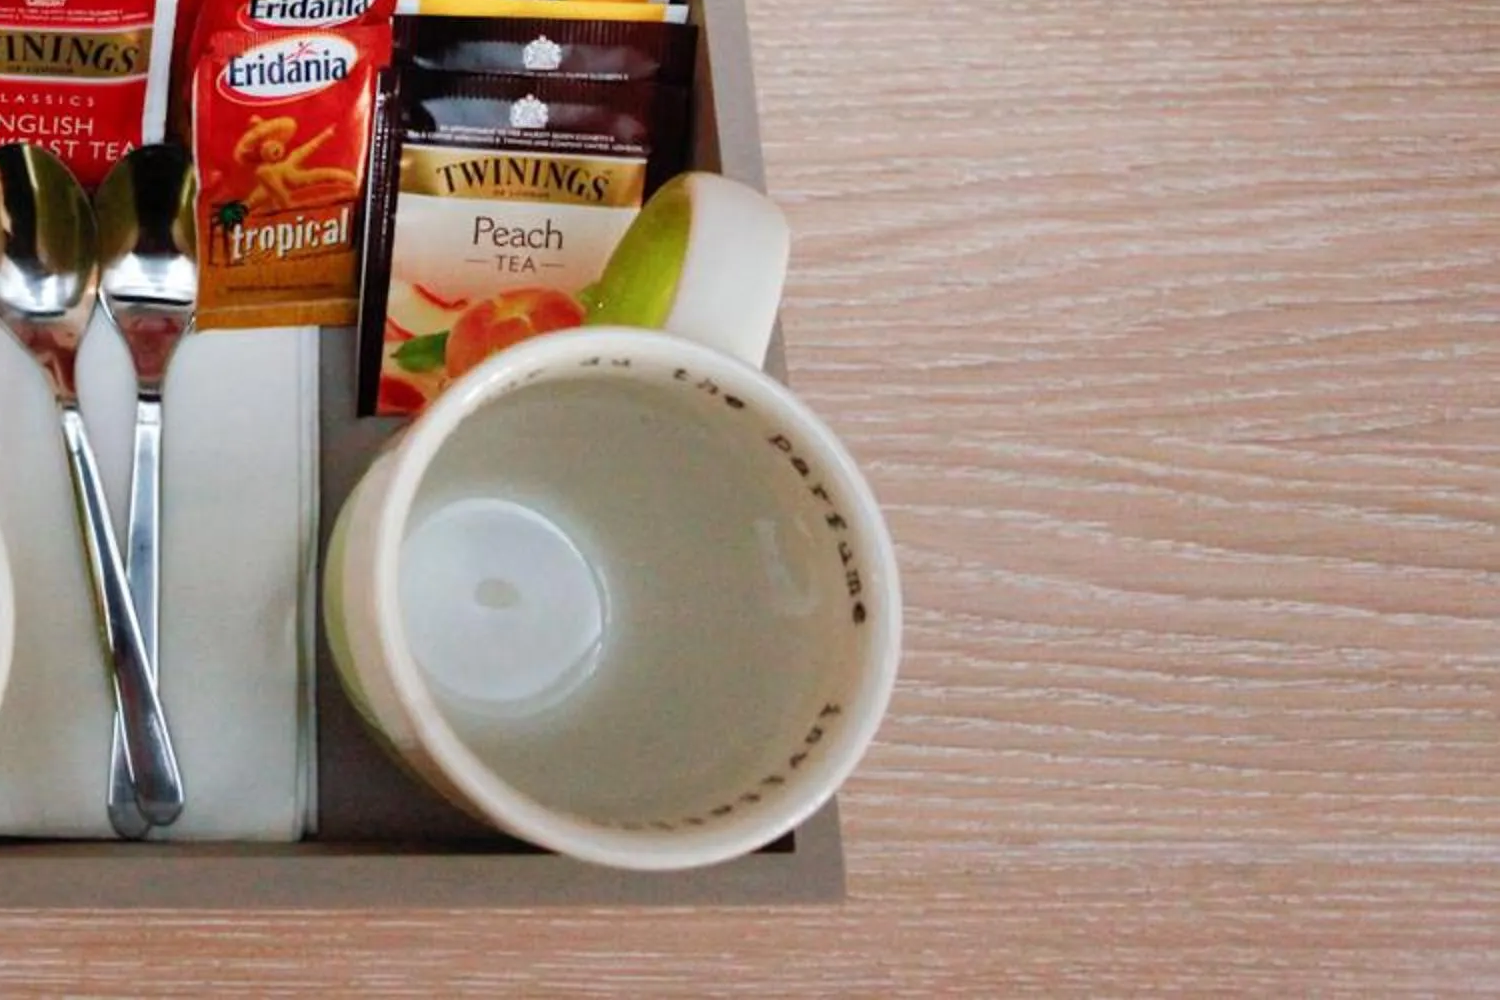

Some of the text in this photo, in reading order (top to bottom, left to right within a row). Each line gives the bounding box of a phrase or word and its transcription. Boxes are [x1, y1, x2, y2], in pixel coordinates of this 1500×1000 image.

[228, 50, 348, 87] Eridania
[436, 157, 610, 200] TWININGS
[231, 207, 349, 261] tropical
[473, 215, 564, 249] Peach
[495, 255, 536, 273] TEA
